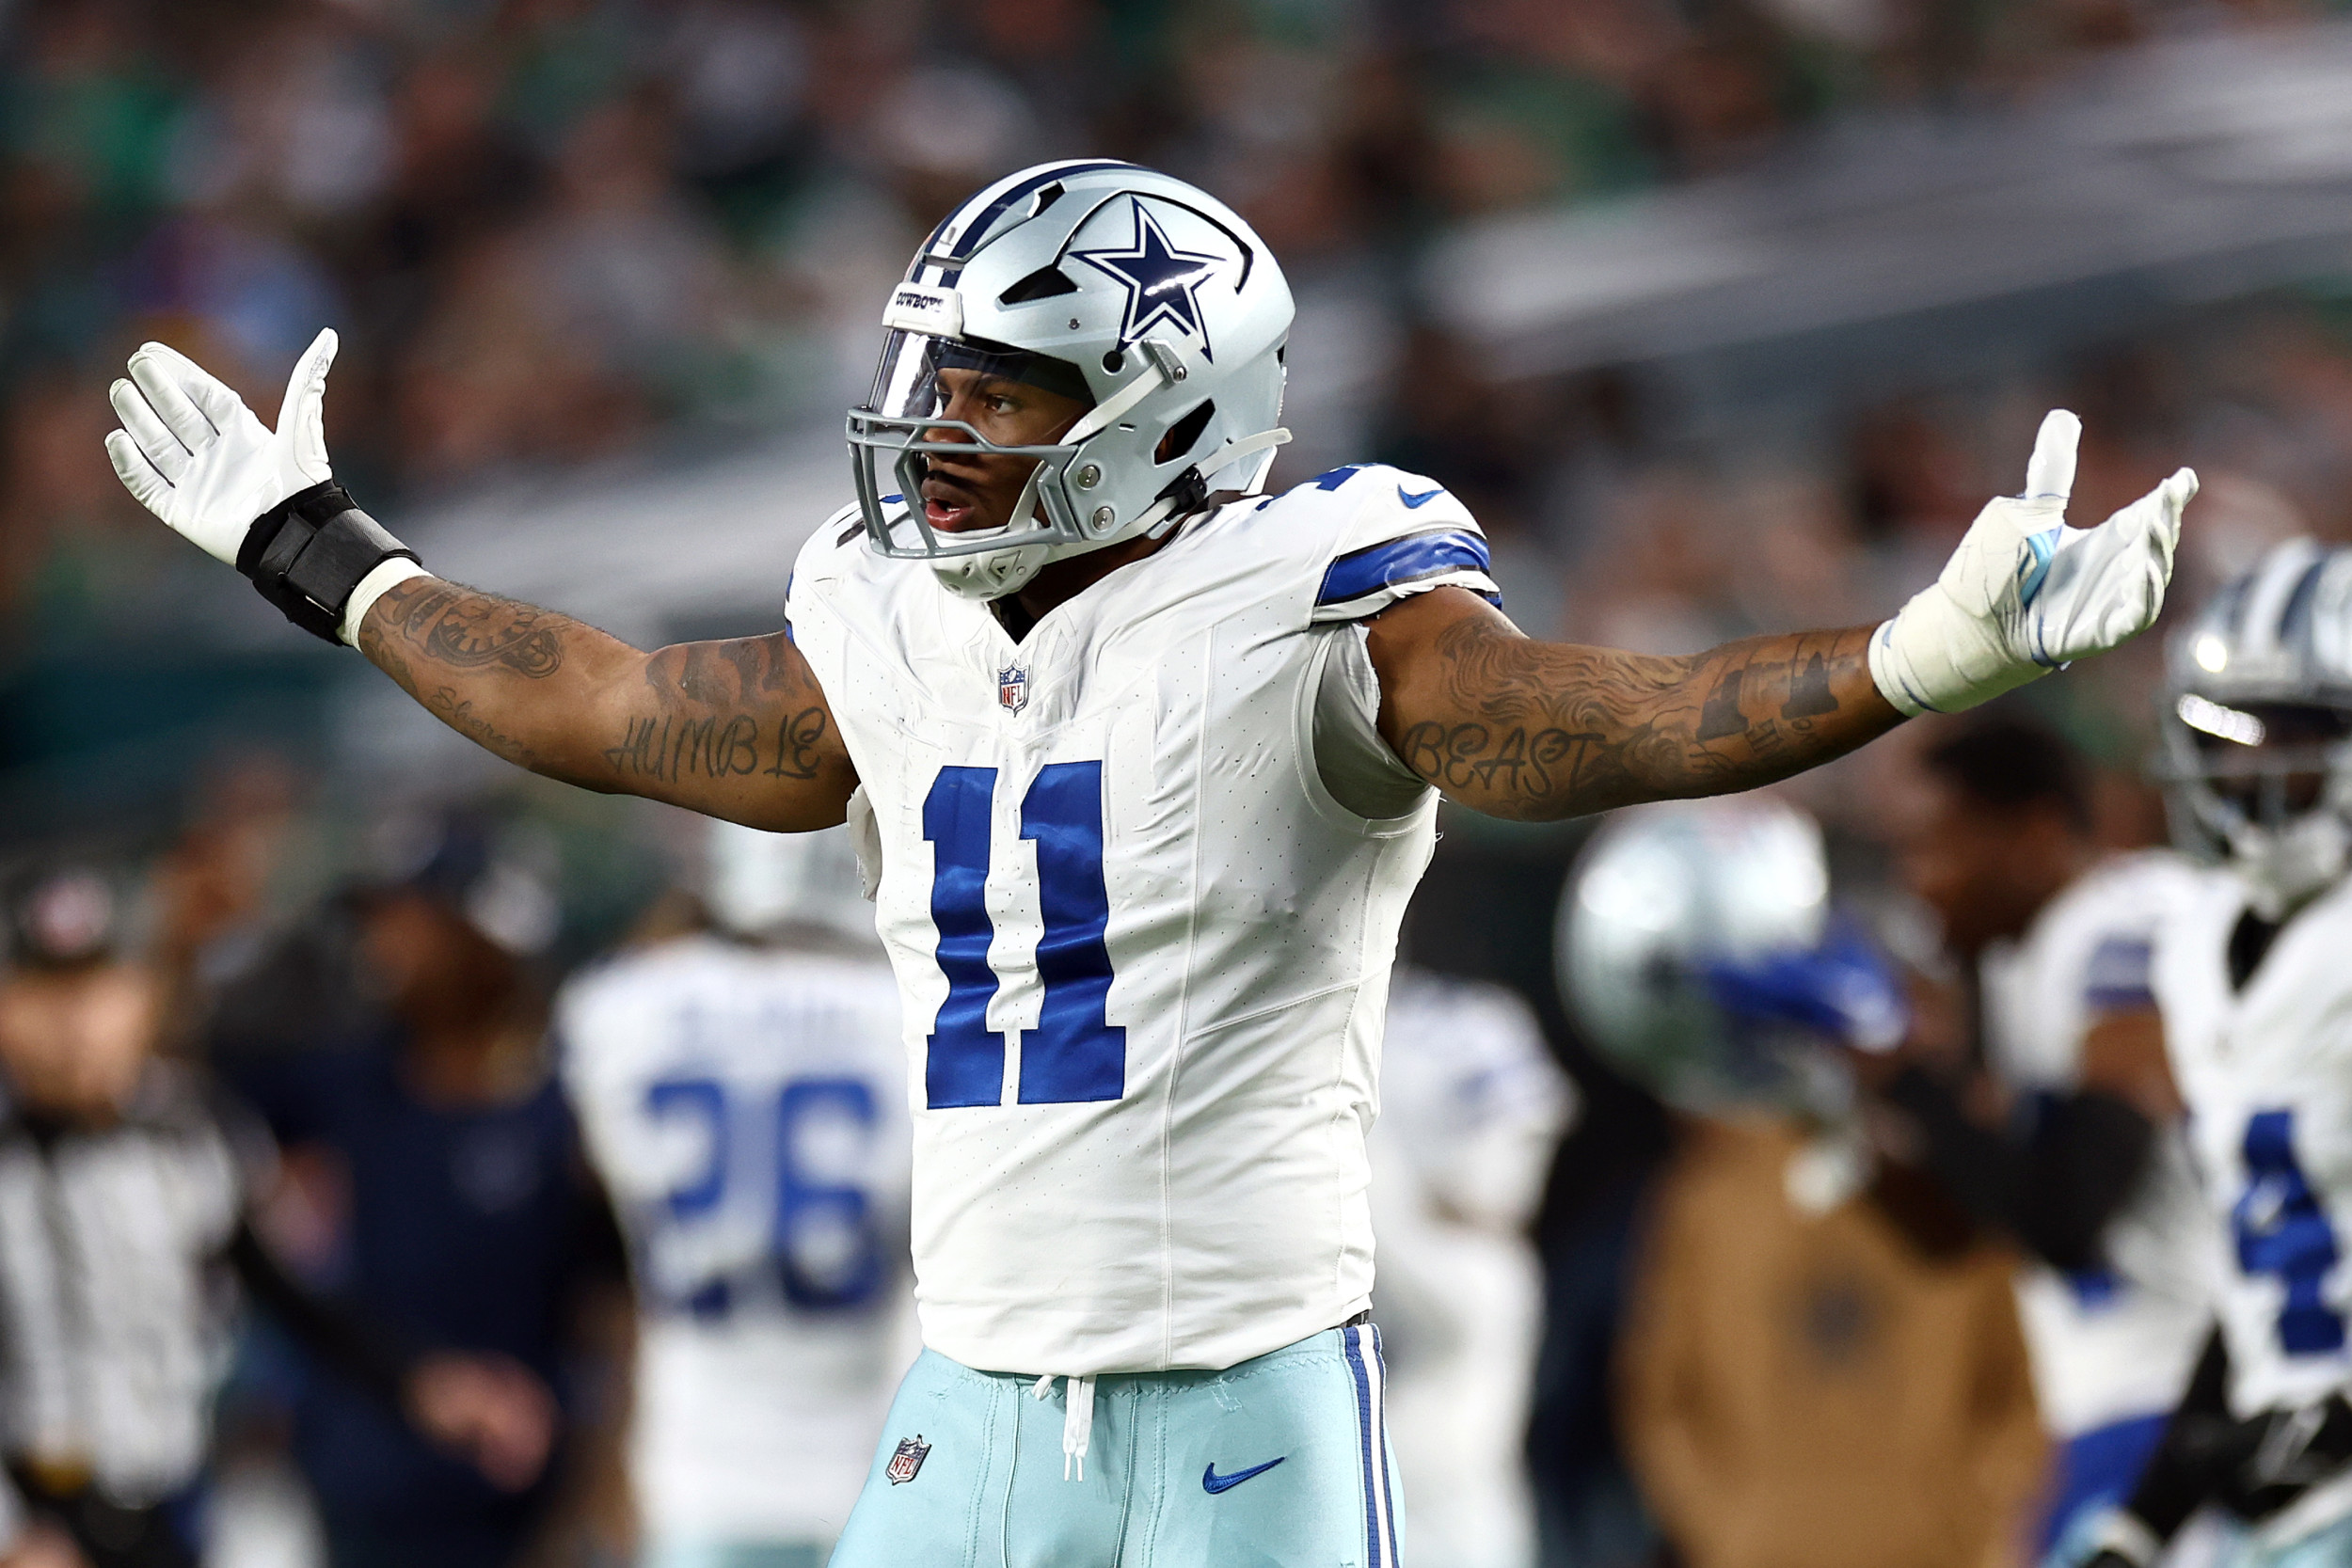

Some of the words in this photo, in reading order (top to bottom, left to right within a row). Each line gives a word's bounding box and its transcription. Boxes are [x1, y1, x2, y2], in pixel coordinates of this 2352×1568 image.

[1002, 685, 1023, 705] NFL
[605, 707, 826, 784] HUMBLE
[1404, 721, 1607, 798] BEAST
[922, 759, 1127, 1111] 11
[644, 1077, 886, 1317] 26
[2232, 1110, 2344, 1353] 4
[891, 1455, 914, 1475] NFL
